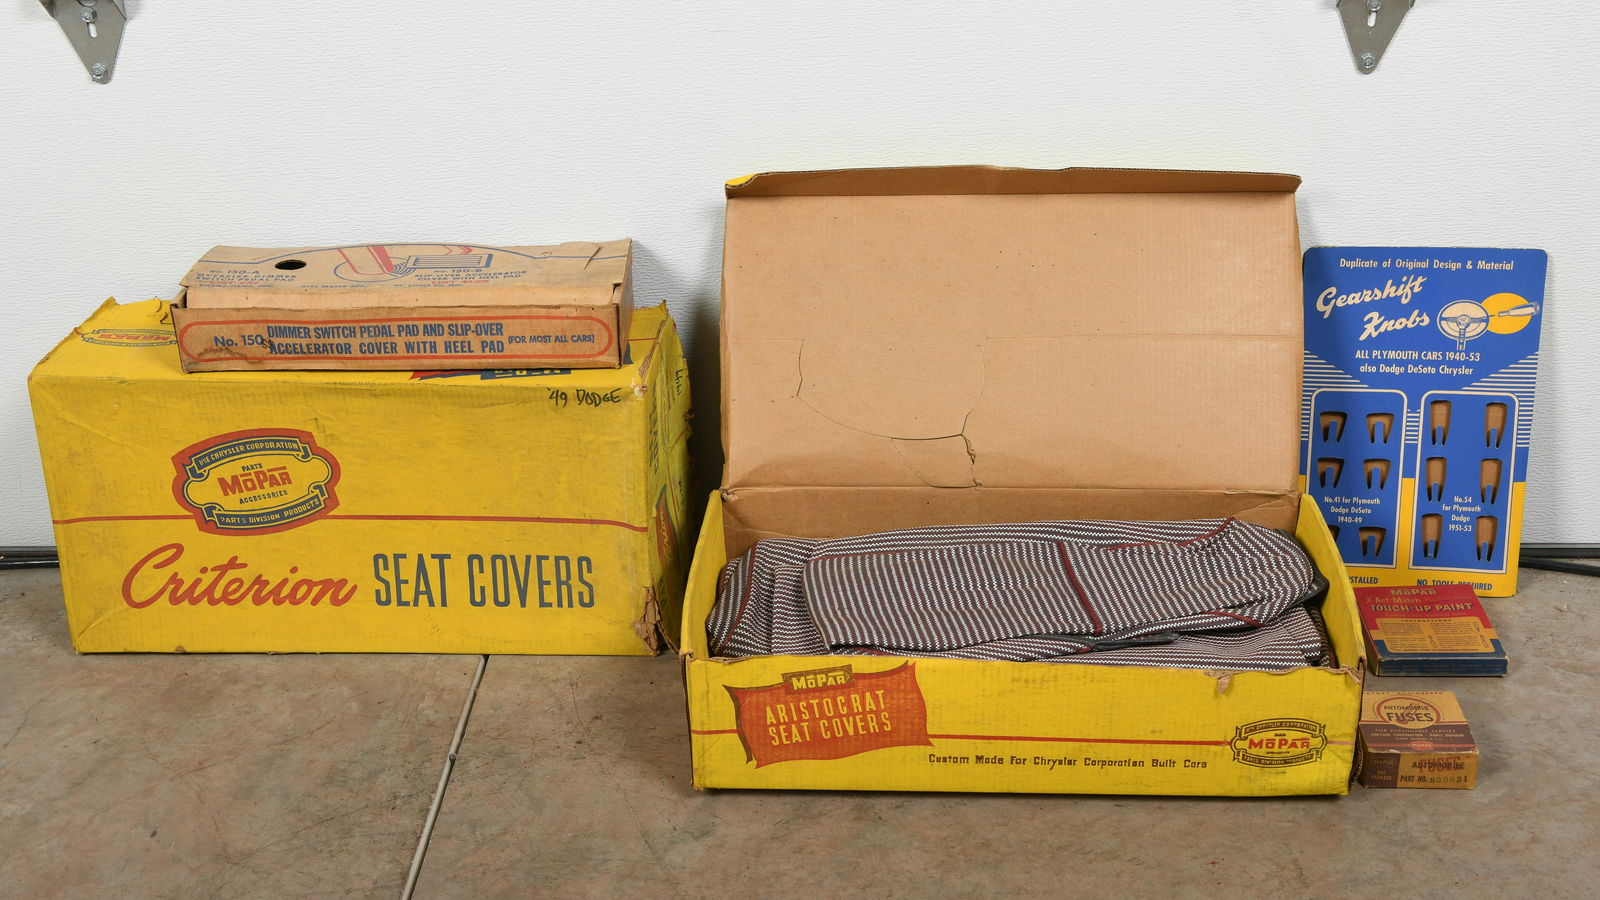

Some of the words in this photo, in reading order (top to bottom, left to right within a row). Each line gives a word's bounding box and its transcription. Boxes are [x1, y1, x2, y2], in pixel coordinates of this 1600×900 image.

[1339, 258, 1378, 269] Duplicate
[1382, 258, 1391, 268] of
[1395, 258, 1429, 270] Original
[1433, 259, 1462, 270] Design
[1466, 260, 1473, 269] &
[1477, 260, 1514, 270] Material
[1315, 274, 1428, 319] Gearshift
[267, 326, 311, 339] DIMMER
[314, 325, 356, 339] SWITCH
[360, 324, 394, 338] PEDAL
[397, 324, 419, 337] PAD
[422, 323, 445, 337] AND
[448, 322, 504, 337] SLIP-OVER
[1359, 309, 1430, 341] Knobs
[213, 336, 238, 347] No.
[241, 334, 264, 346] 150
[508, 335, 526, 344] (FOR
[529, 335, 552, 343] MOST
[554, 335, 568, 343] ALL
[571, 334, 595, 343] CARS)
[271, 342, 352, 355] ACCELERATOR
[359, 342, 398, 354] COVER
[405, 341, 437, 353] WITH
[444, 341, 474, 353] HEEL
[481, 340, 505, 353] PAD
[1355, 350, 1369, 360] ALL
[1372, 350, 1418, 361] PLYMOUTH
[1421, 351, 1443, 361] CARS
[1445, 351, 1481, 362] 1940-53
[1360, 363, 1376, 373] also
[1379, 364, 1405, 375] Dodge
[1407, 364, 1436, 374] DeSoto
[1439, 364, 1474, 376] Chrysler
[576, 388, 622, 408] DODGE
[210, 444, 245, 463] CHRYSLER
[245, 440, 299, 451] CORPORATION
[241, 462, 263, 473] PARTS
[239, 490, 288, 505] ACCESSORIES
[1324, 496, 1341, 504] No.41
[1342, 496, 1351, 504] for
[1352, 496, 1381, 505] Plymouth
[249, 513, 280, 524] DIVISION
[283, 498, 320, 518] PRODUCTS
[1331, 506, 1349, 515] Dodge
[1453, 504, 1481, 513] Plymouth
[1337, 516, 1362, 524] 1940-49
[1451, 514, 1470, 522] Dodge
[1449, 524, 1472, 532] 1951-53
[121, 542, 358, 609] Criterion
[372, 553, 451, 608] SEAT
[467, 553, 595, 609] COVERS
[1349, 576, 1379, 585] STALLED
[1416, 579, 1428, 587] NO
[1371, 604, 1432, 613] TOUCH-UP
[1435, 602, 1474, 612] PAINT
[766, 690, 886, 725] ARISTOCRAT
[1386, 712, 1435, 722] FUSES
[768, 722, 810, 746] SEAT
[819, 712, 893, 740] COVERS
[928, 753, 970, 765] Custom
[975, 755, 1004, 765] Made
[1010, 756, 1027, 765] For
[1033, 756, 1077, 770] Chrysler
[1084, 757, 1145, 769] Corporation
[1152, 758, 1176, 768] Built
[1184, 759, 1208, 769] Cars
[1412, 761, 1465, 770] AUTOMOBILE
[1400, 775, 1415, 783] PART
[1418, 775, 1428, 783] NO.
